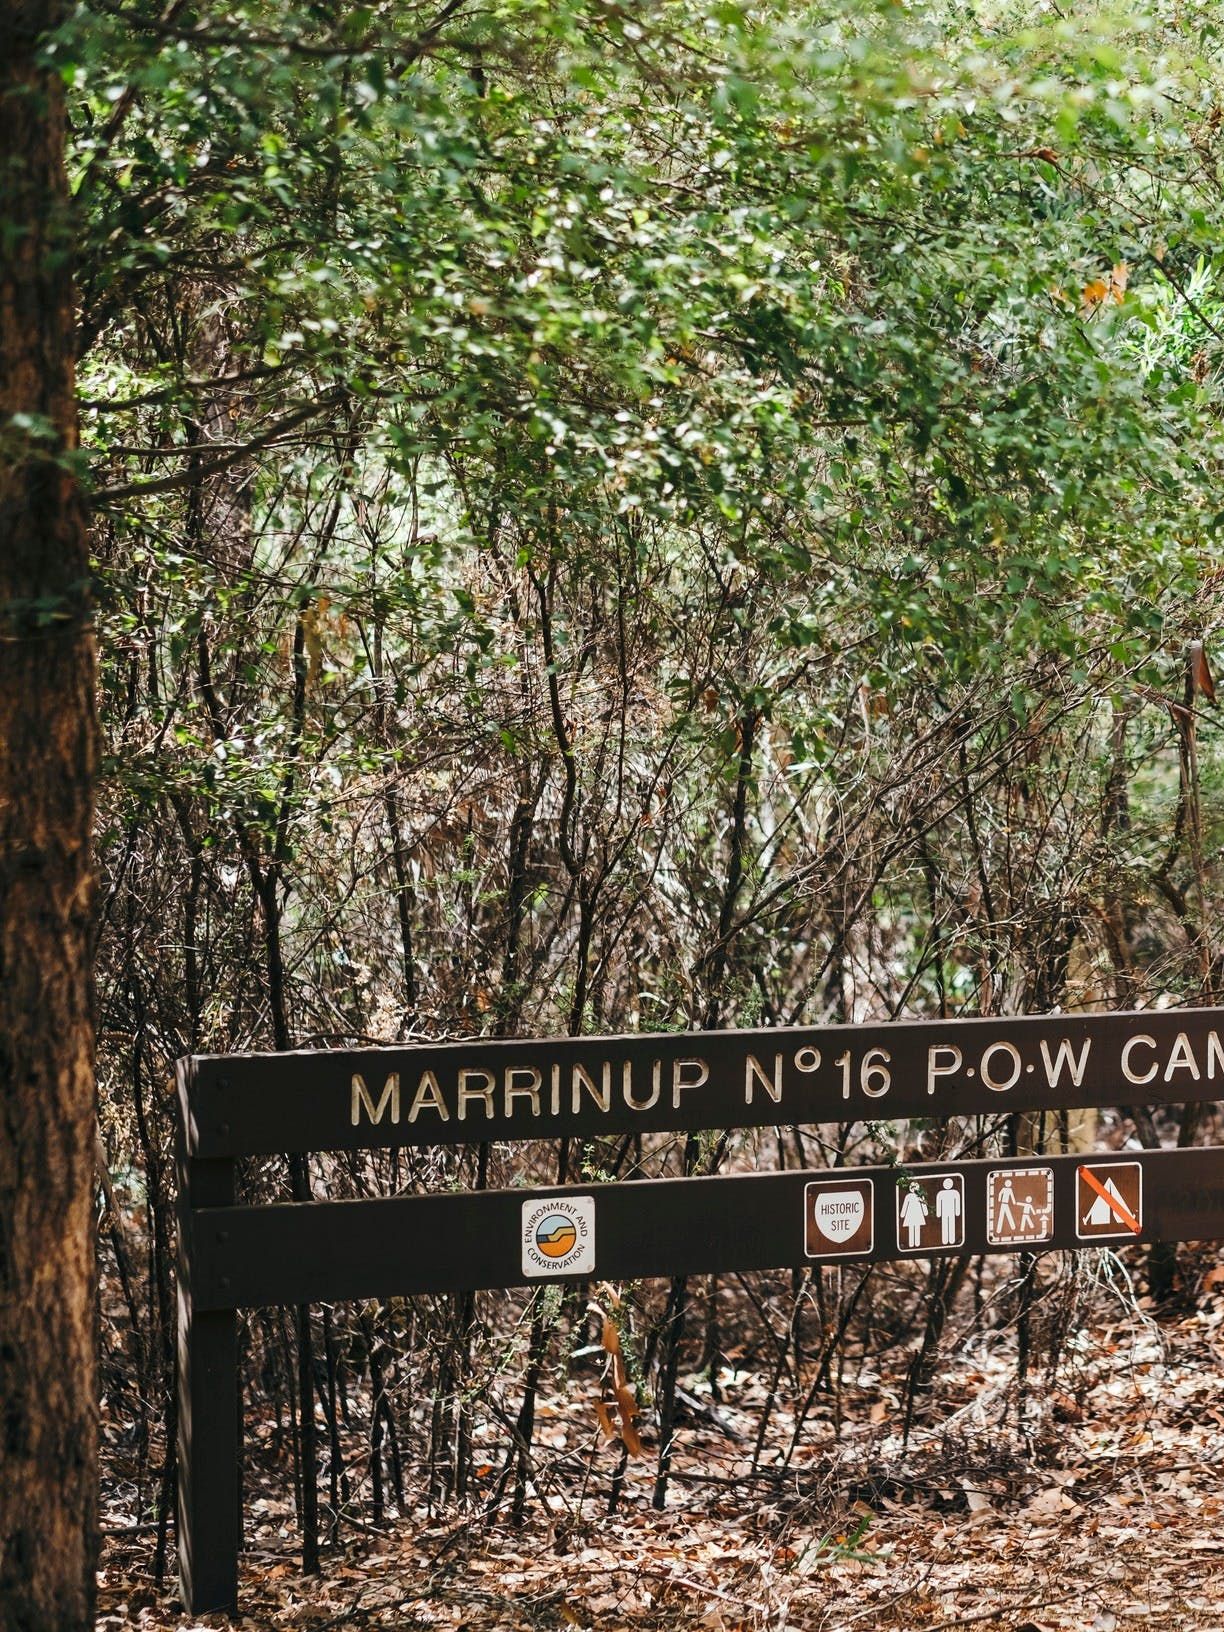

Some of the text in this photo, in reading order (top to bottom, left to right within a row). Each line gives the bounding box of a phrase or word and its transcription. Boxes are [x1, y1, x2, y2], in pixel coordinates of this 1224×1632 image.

[350, 1057, 710, 1126] MARRINUP
[524, 1201, 589, 1244] ENVIRONMENT AND
[820, 1202, 860, 1216] HISTORIC
[831, 1219, 851, 1232] SITE
[527, 1243, 586, 1270] CONSERVATION
